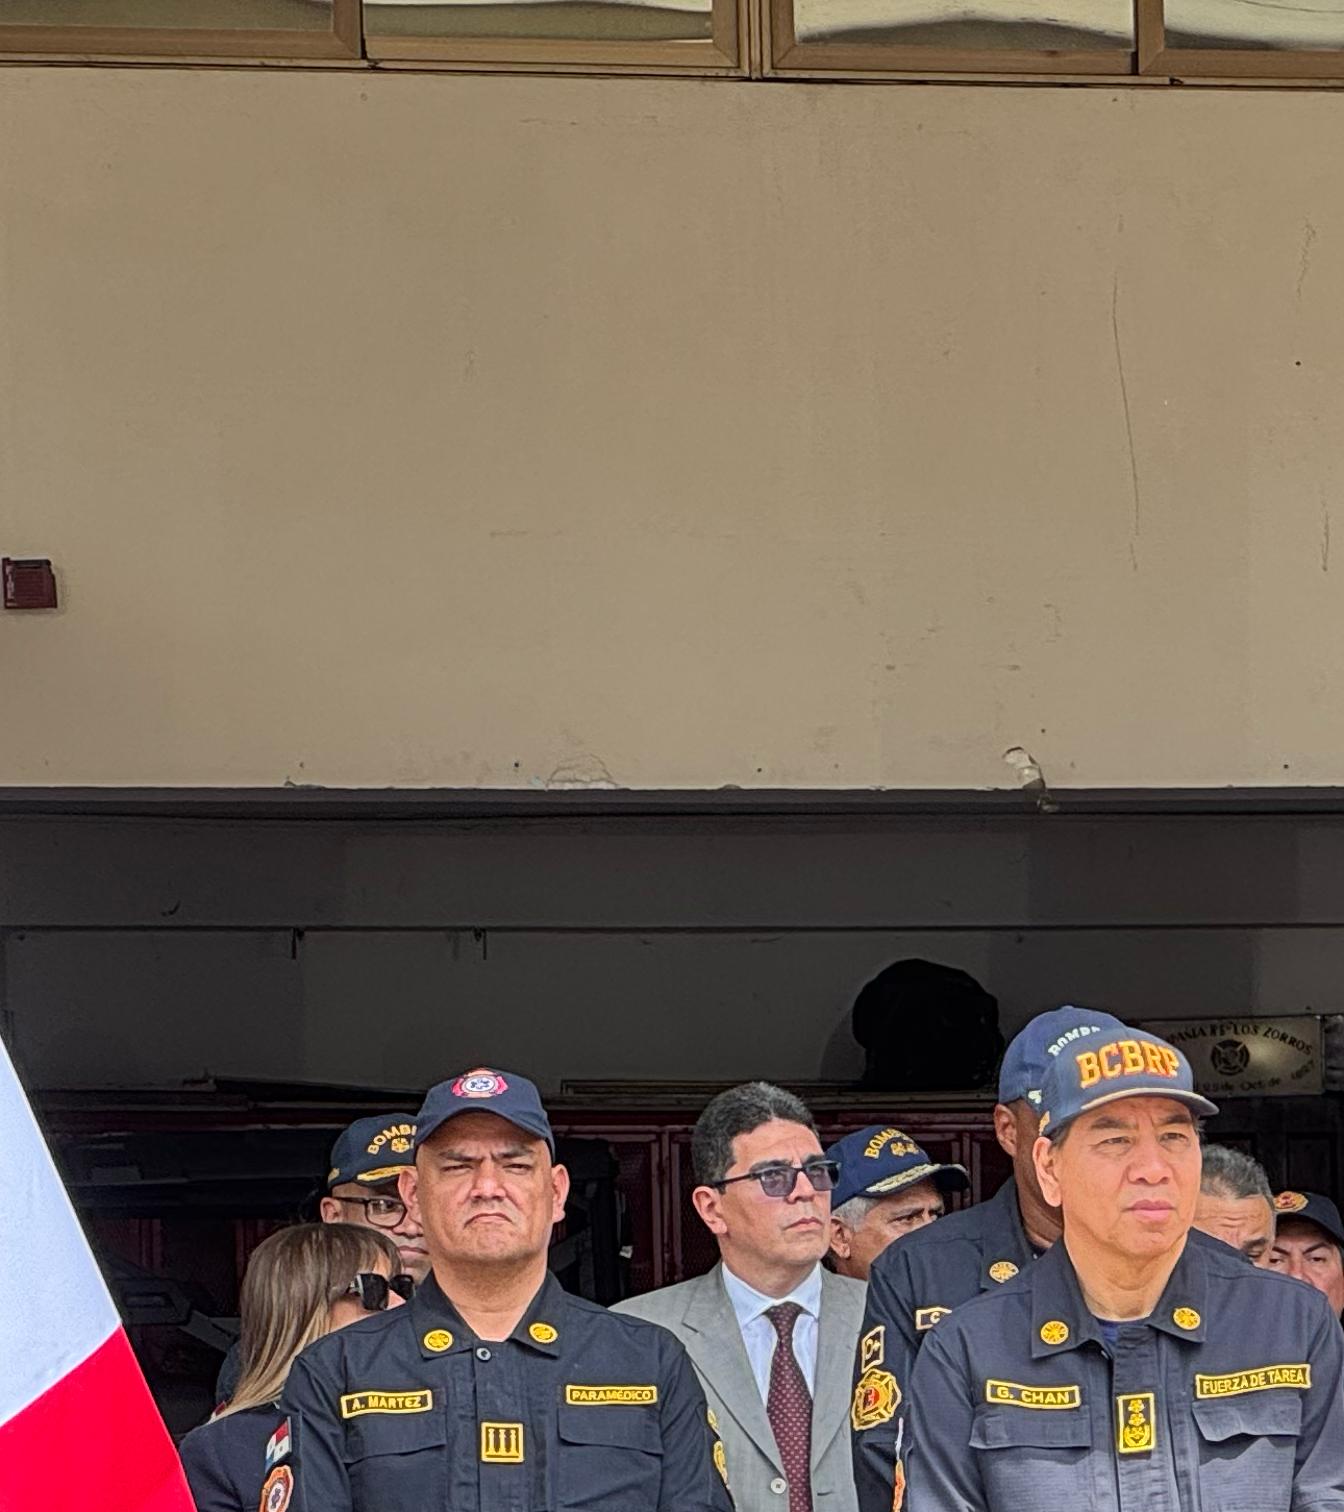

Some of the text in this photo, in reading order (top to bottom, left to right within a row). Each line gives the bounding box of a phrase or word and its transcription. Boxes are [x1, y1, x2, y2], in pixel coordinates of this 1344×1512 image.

[1262, 1026, 1313, 1056] ZORROS
[1075, 1039, 1180, 1089] BCBRP
[1203, 1368, 1304, 1394] FUERZA DE TAREA
[352, 1395, 422, 1410] A. MARTEZ
[997, 1386, 1070, 1404] G. CHAN
